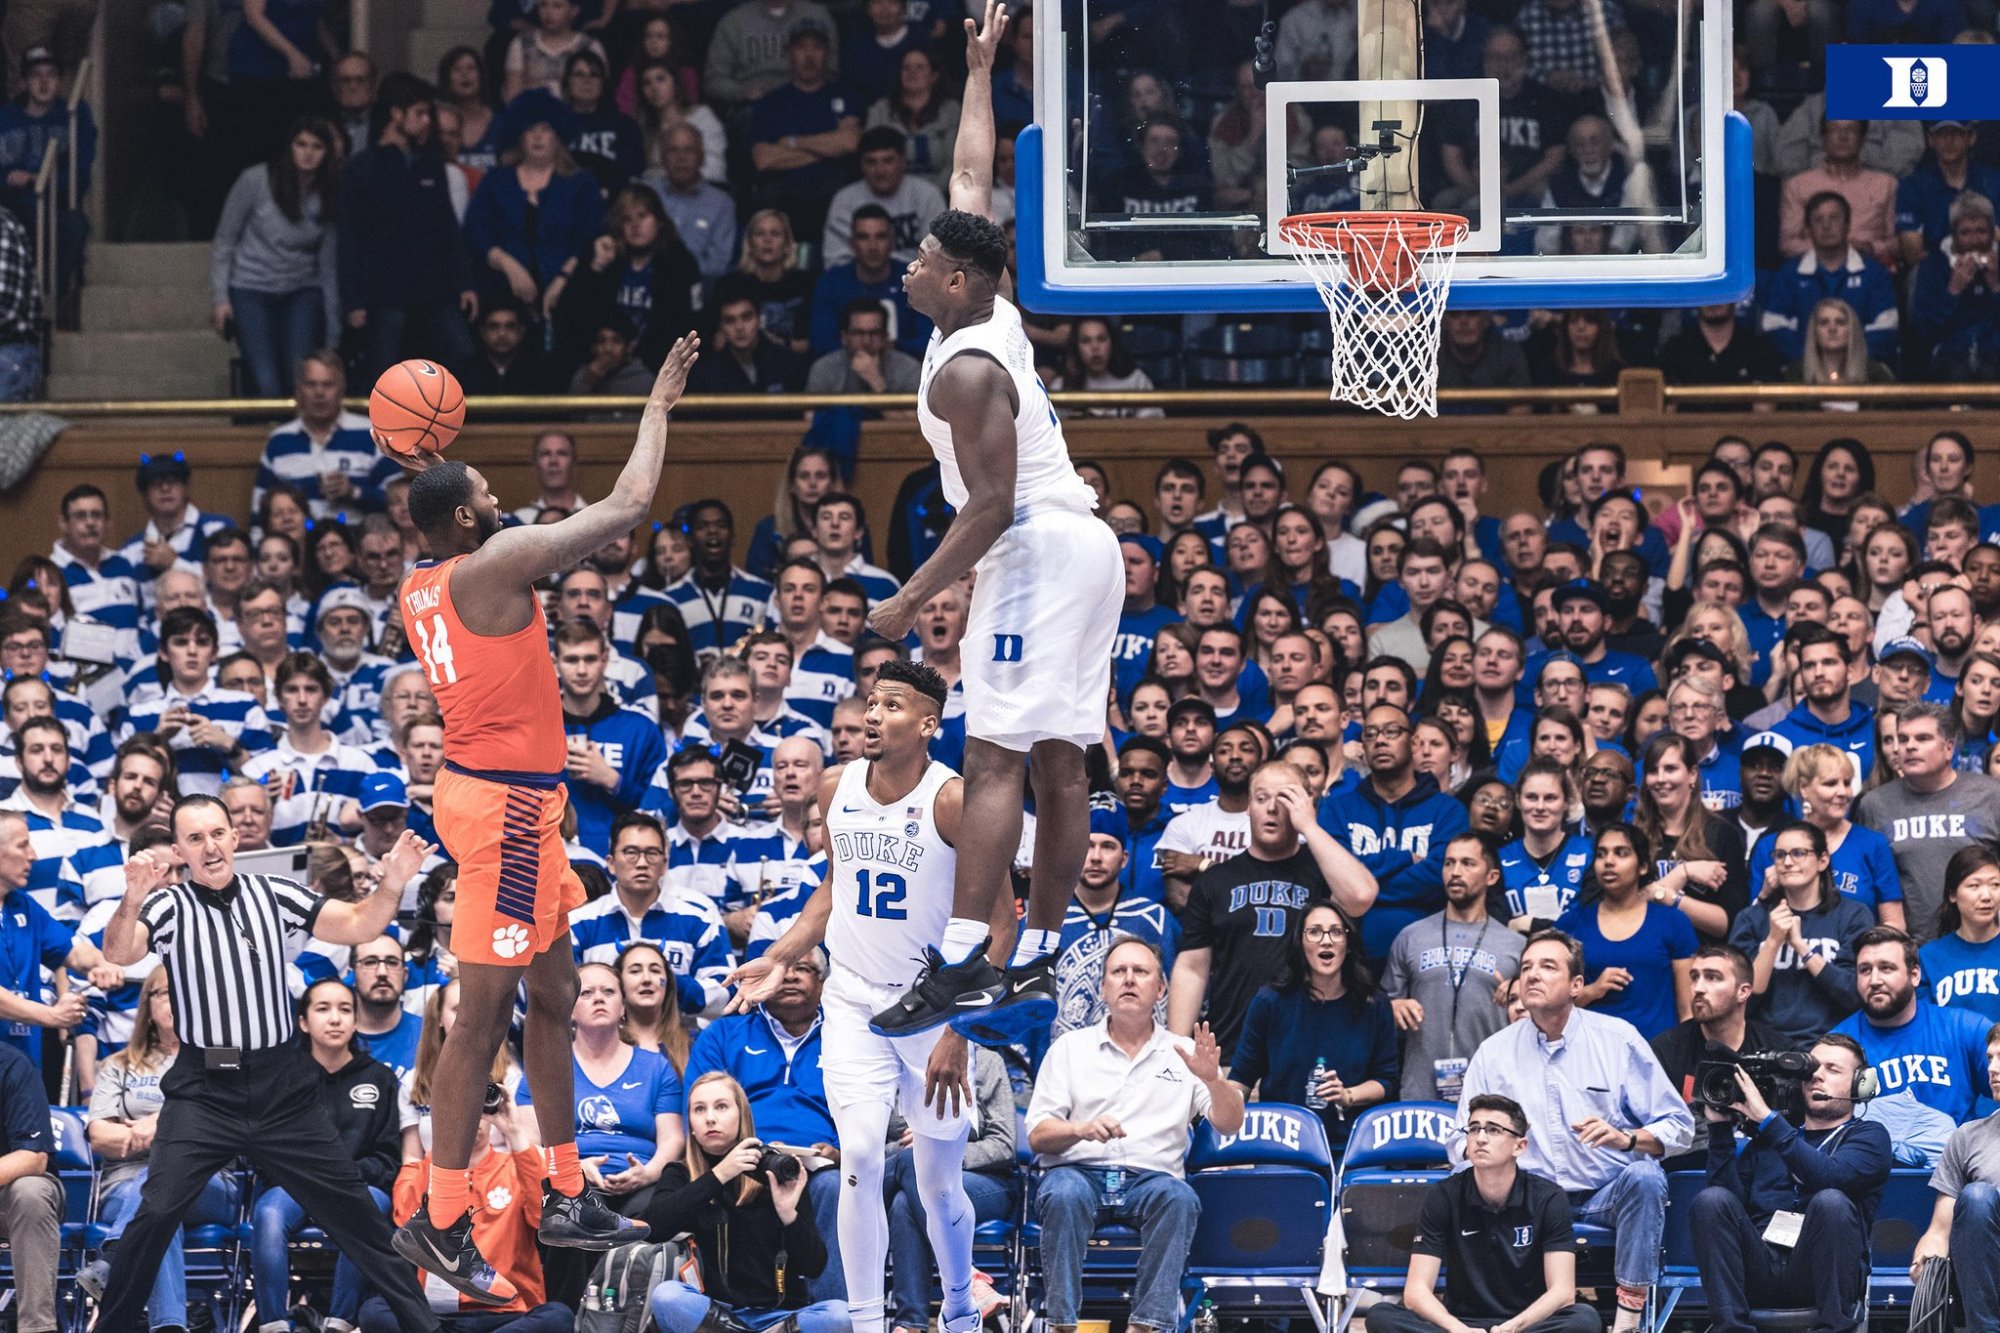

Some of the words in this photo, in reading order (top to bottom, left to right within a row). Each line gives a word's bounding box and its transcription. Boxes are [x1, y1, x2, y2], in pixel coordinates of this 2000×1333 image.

[405, 585, 442, 617] THOMAS
[415, 613, 457, 685] 14
[992, 633, 1024, 662] D
[1211, 830, 1247, 850] ALL
[1893, 814, 1966, 842] DUKE
[834, 832, 924, 873] DUKE
[856, 868, 908, 920] 12
[1229, 880, 1310, 913] DUKE
[1936, 967, 2000, 1008] DUK
[1372, 1109, 1456, 1150] DUKE
